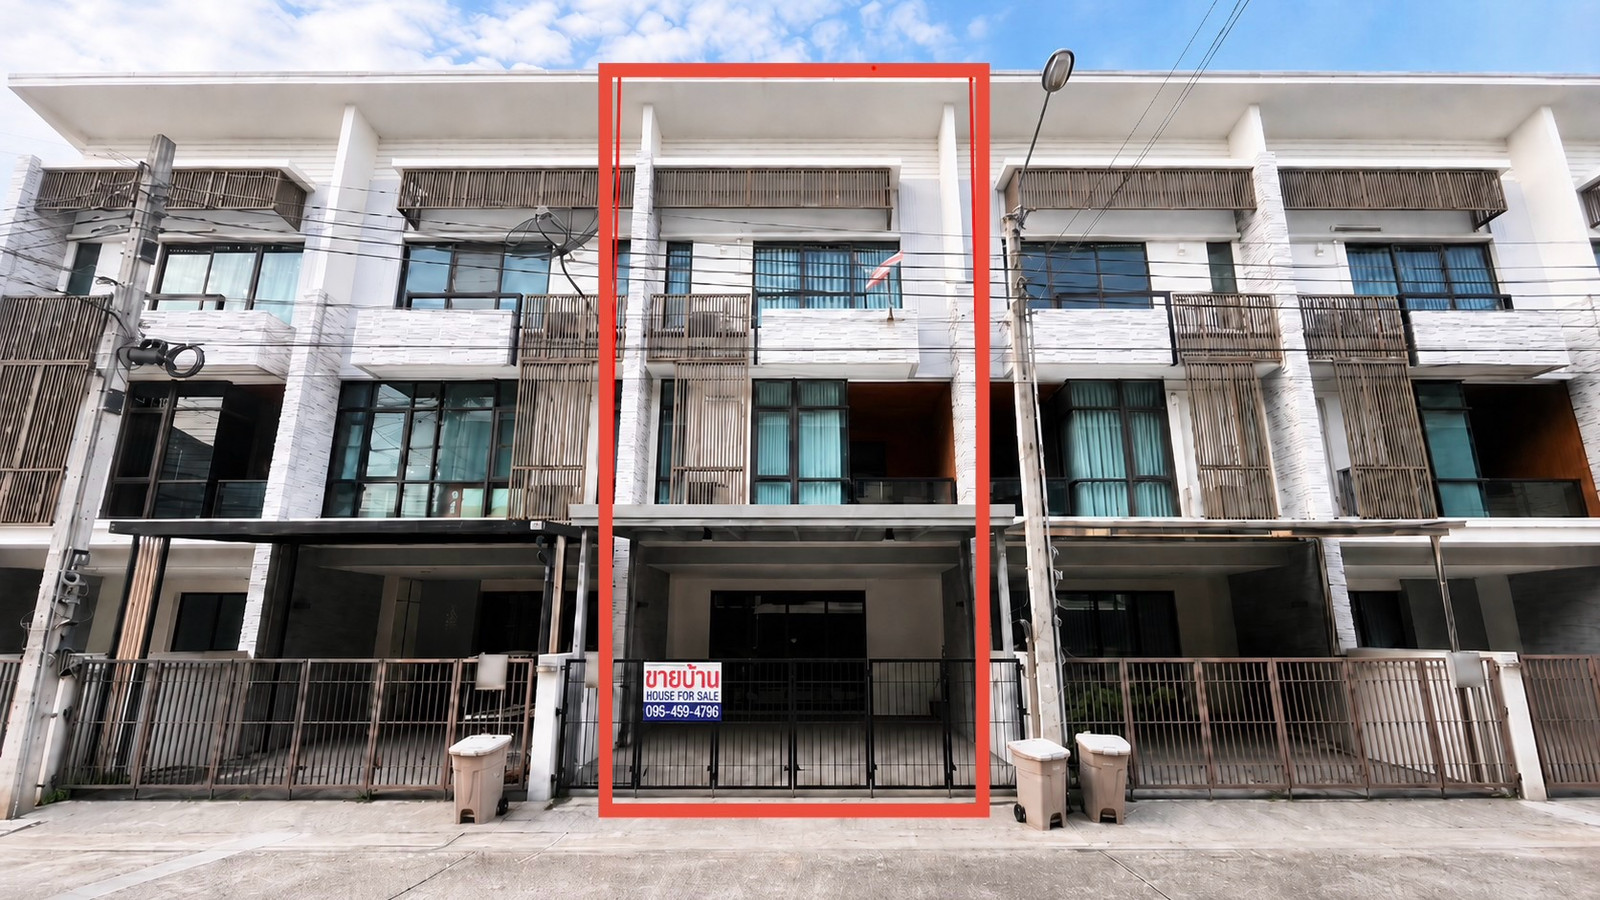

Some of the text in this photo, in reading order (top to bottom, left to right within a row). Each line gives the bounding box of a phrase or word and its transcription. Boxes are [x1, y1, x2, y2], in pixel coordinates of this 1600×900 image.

[646, 664, 719, 688] ขายบ้าน
[646, 691, 719, 701] HOUSE FOR SALE
